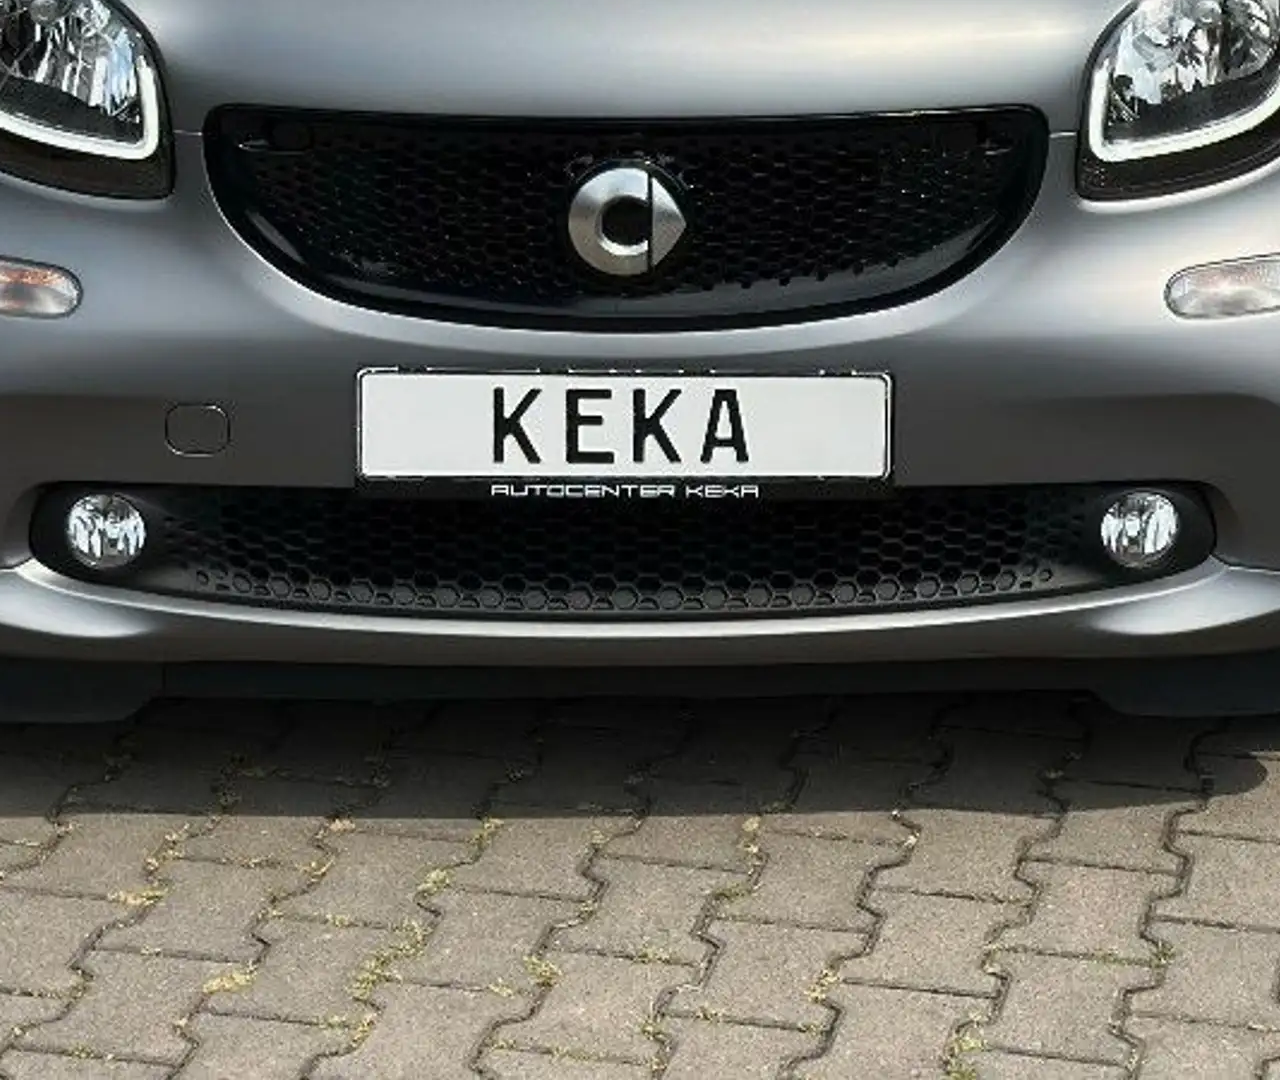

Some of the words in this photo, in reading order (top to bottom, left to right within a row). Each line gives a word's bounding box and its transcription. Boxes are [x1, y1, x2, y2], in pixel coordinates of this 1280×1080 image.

[493, 387, 749, 463] KEKA
[490, 484, 675, 499] AUTOCENTER
[685, 484, 759, 499] KEKA
